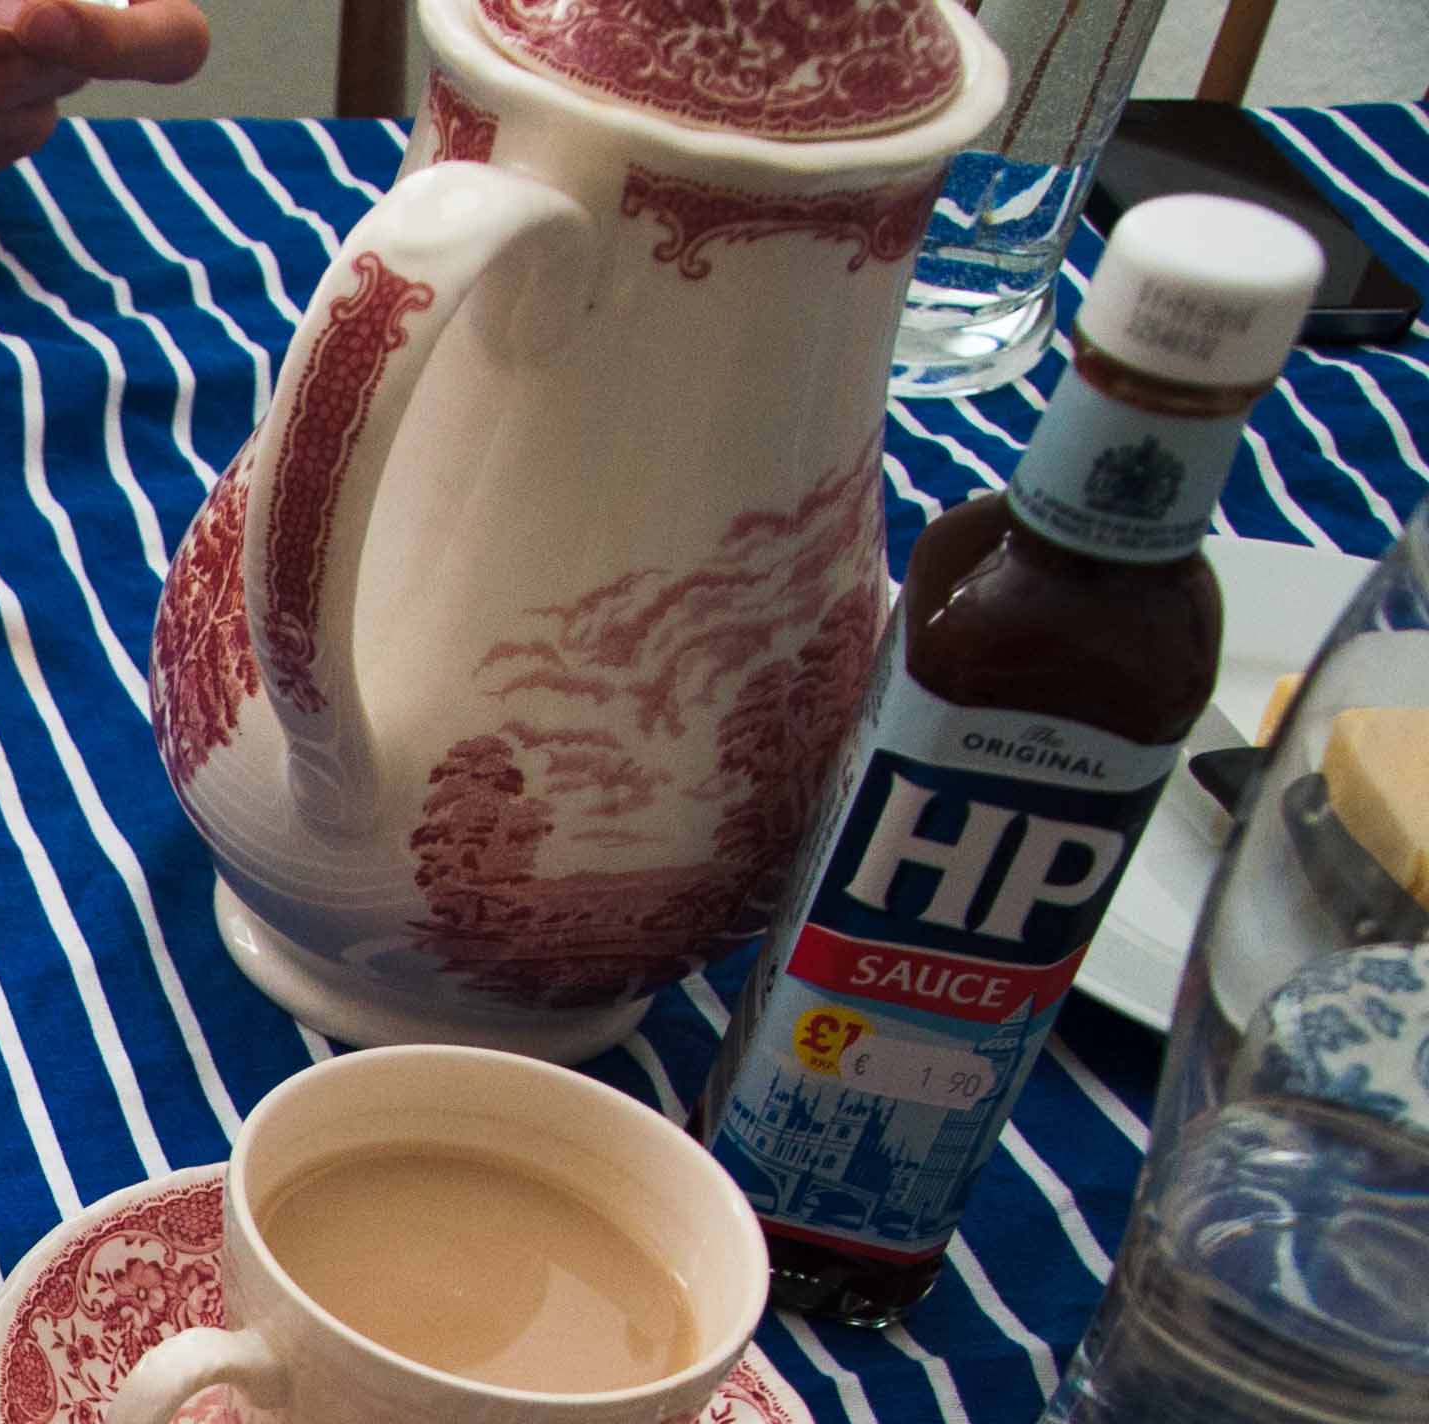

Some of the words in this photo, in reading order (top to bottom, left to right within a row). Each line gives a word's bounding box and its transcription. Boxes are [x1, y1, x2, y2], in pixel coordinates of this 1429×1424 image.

[963, 732, 1107, 779] ORIGINAL
[844, 770, 1126, 943] HP
[850, 954, 1011, 1008] SAUCE
[854, 1053, 870, 1076] €
[948, 1071, 982, 1097] 90
